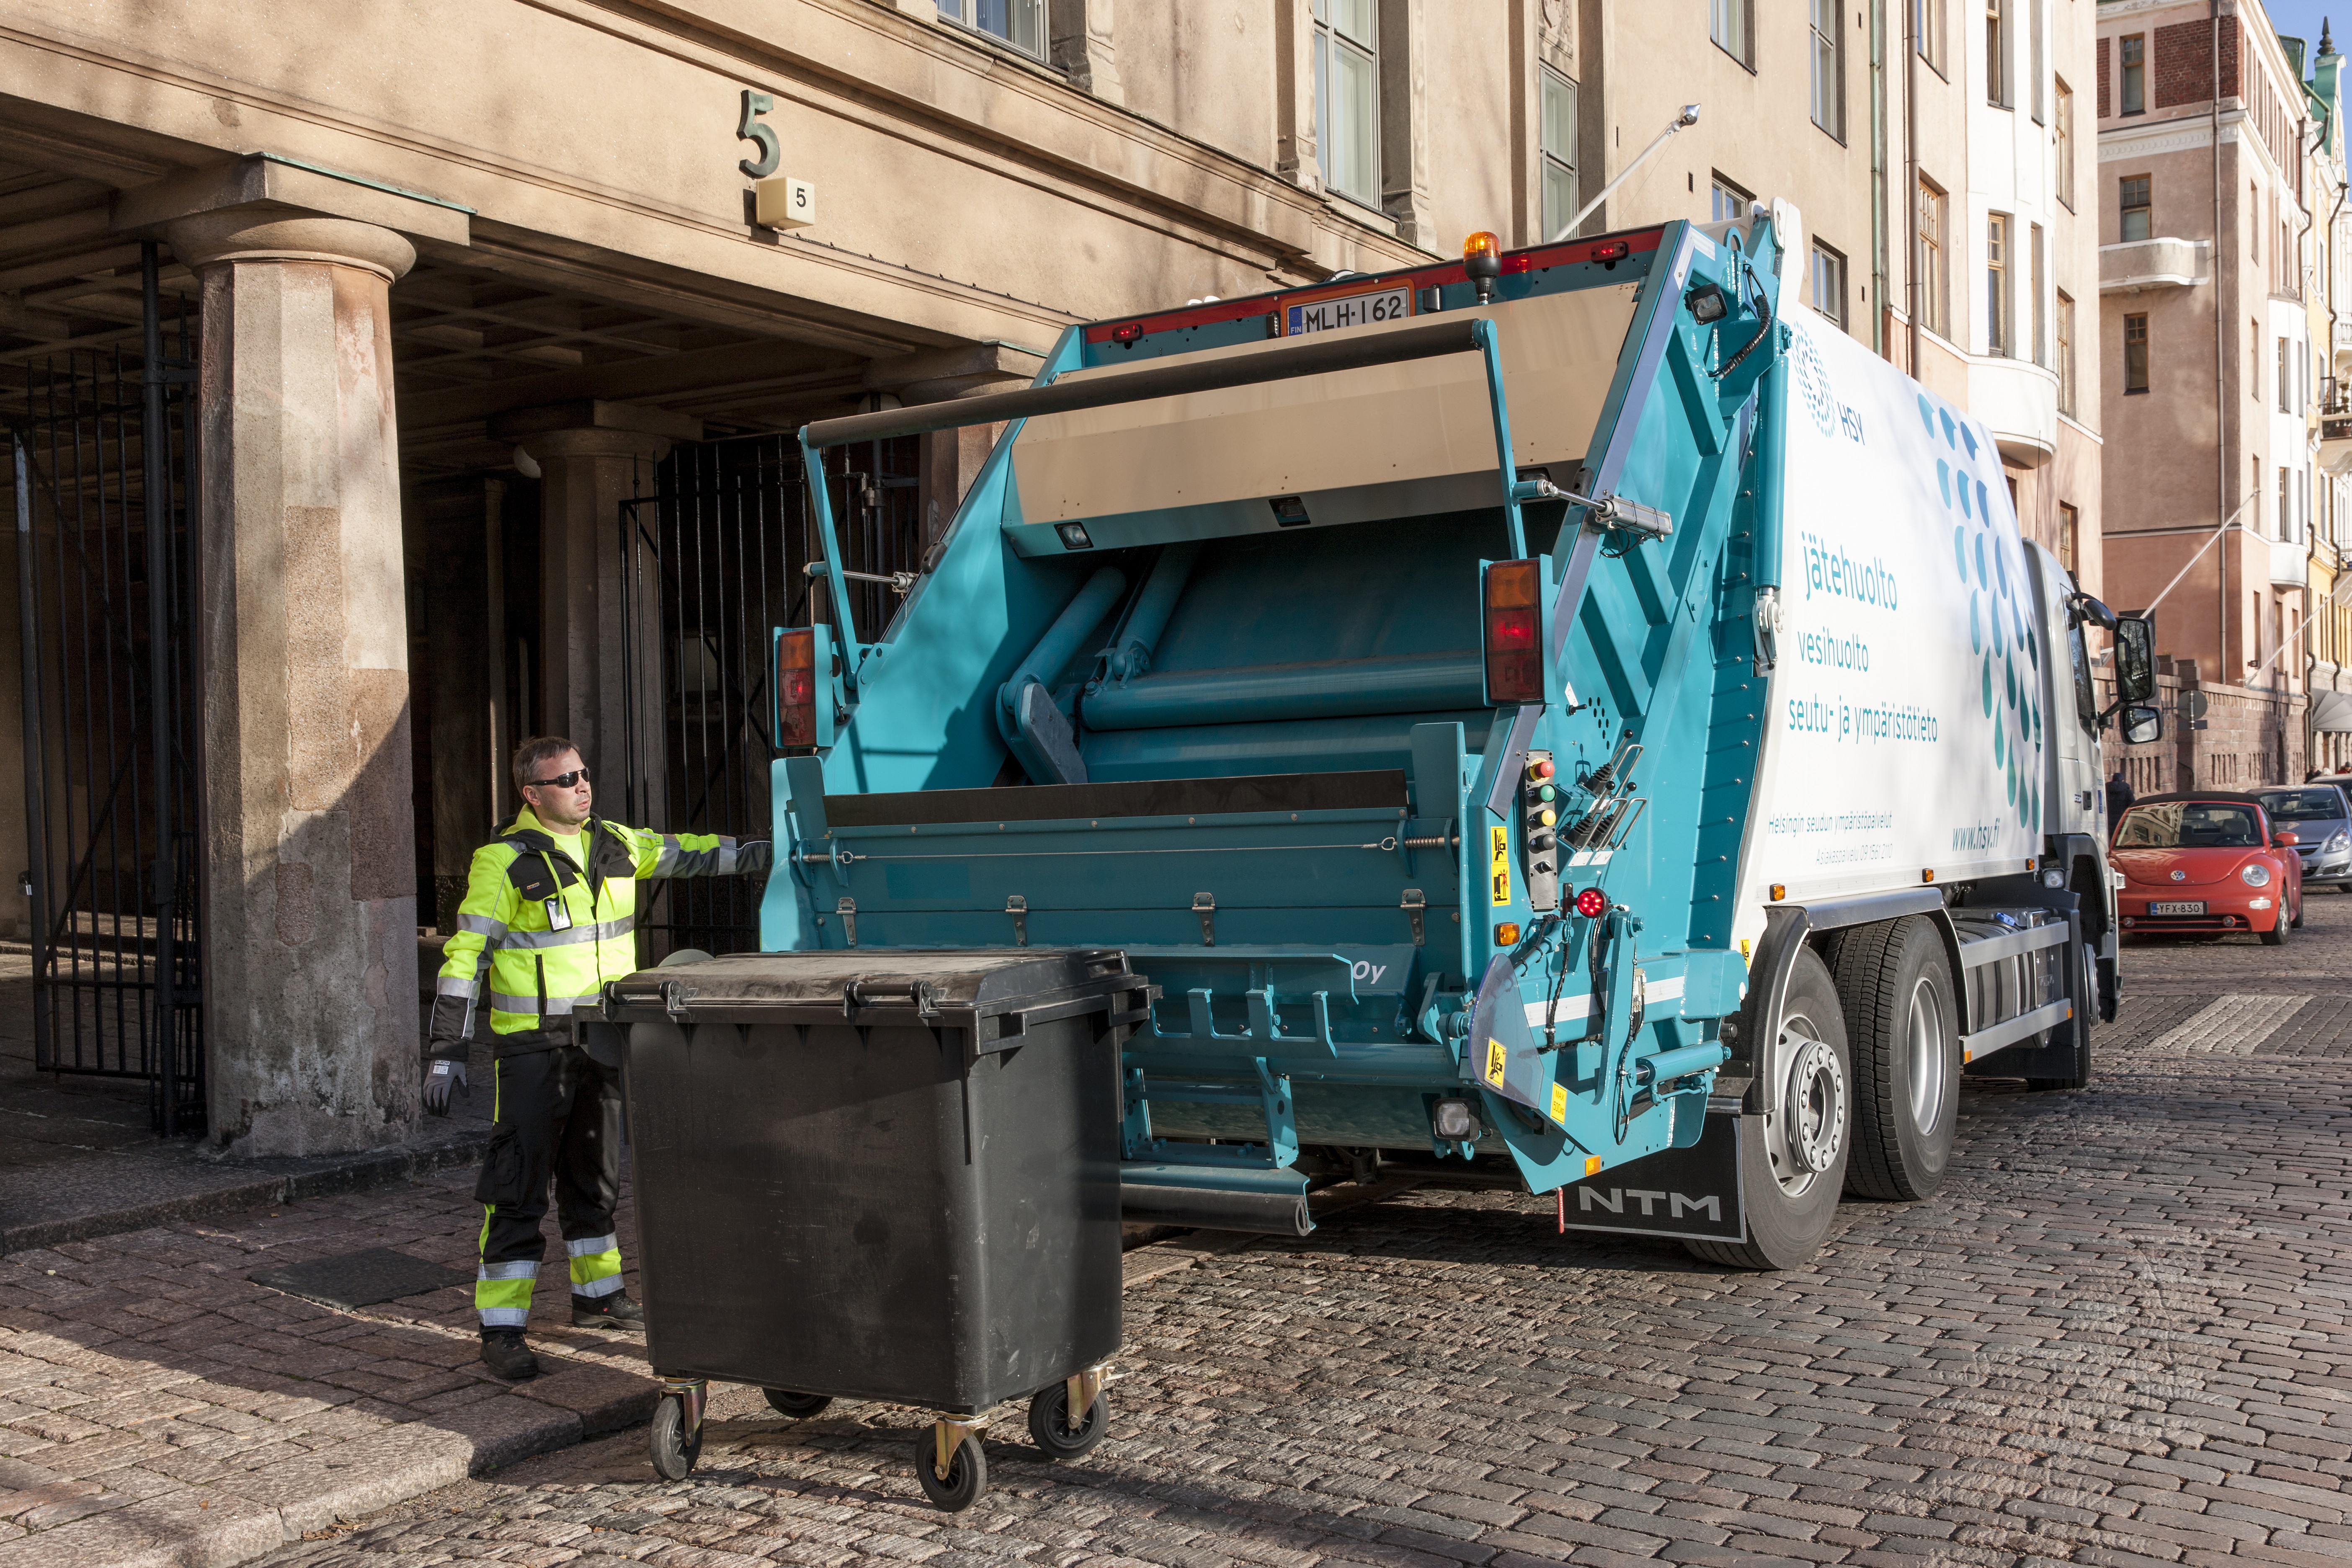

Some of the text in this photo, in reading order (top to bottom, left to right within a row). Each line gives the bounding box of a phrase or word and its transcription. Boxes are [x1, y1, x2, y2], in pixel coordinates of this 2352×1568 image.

[736, 90, 780, 179] 5
[796, 187, 806, 207] 5
[1306, 296, 1401, 333] MLH-162
[1837, 401, 1865, 446] HSY
[1801, 531, 1897, 611] jätehuolto
[1798, 626, 1869, 672] vesihuolto
[1789, 693, 1938, 745] seutu- ja ympäristötieto
[1768, 810, 1892, 838] Helsingin seudun ympäristöpalvelut
[1952, 818, 2000, 856] www.hsy.fi
[1816, 843, 1893, 866] Asiakaspalvelu 09 1561 2110
[2159, 904, 2200, 913] YFX-830
[1353, 960, 1387, 984] Oy
[1555, 1090, 1564, 1101] MAX
[1579, 1186, 1721, 1221] NTM
